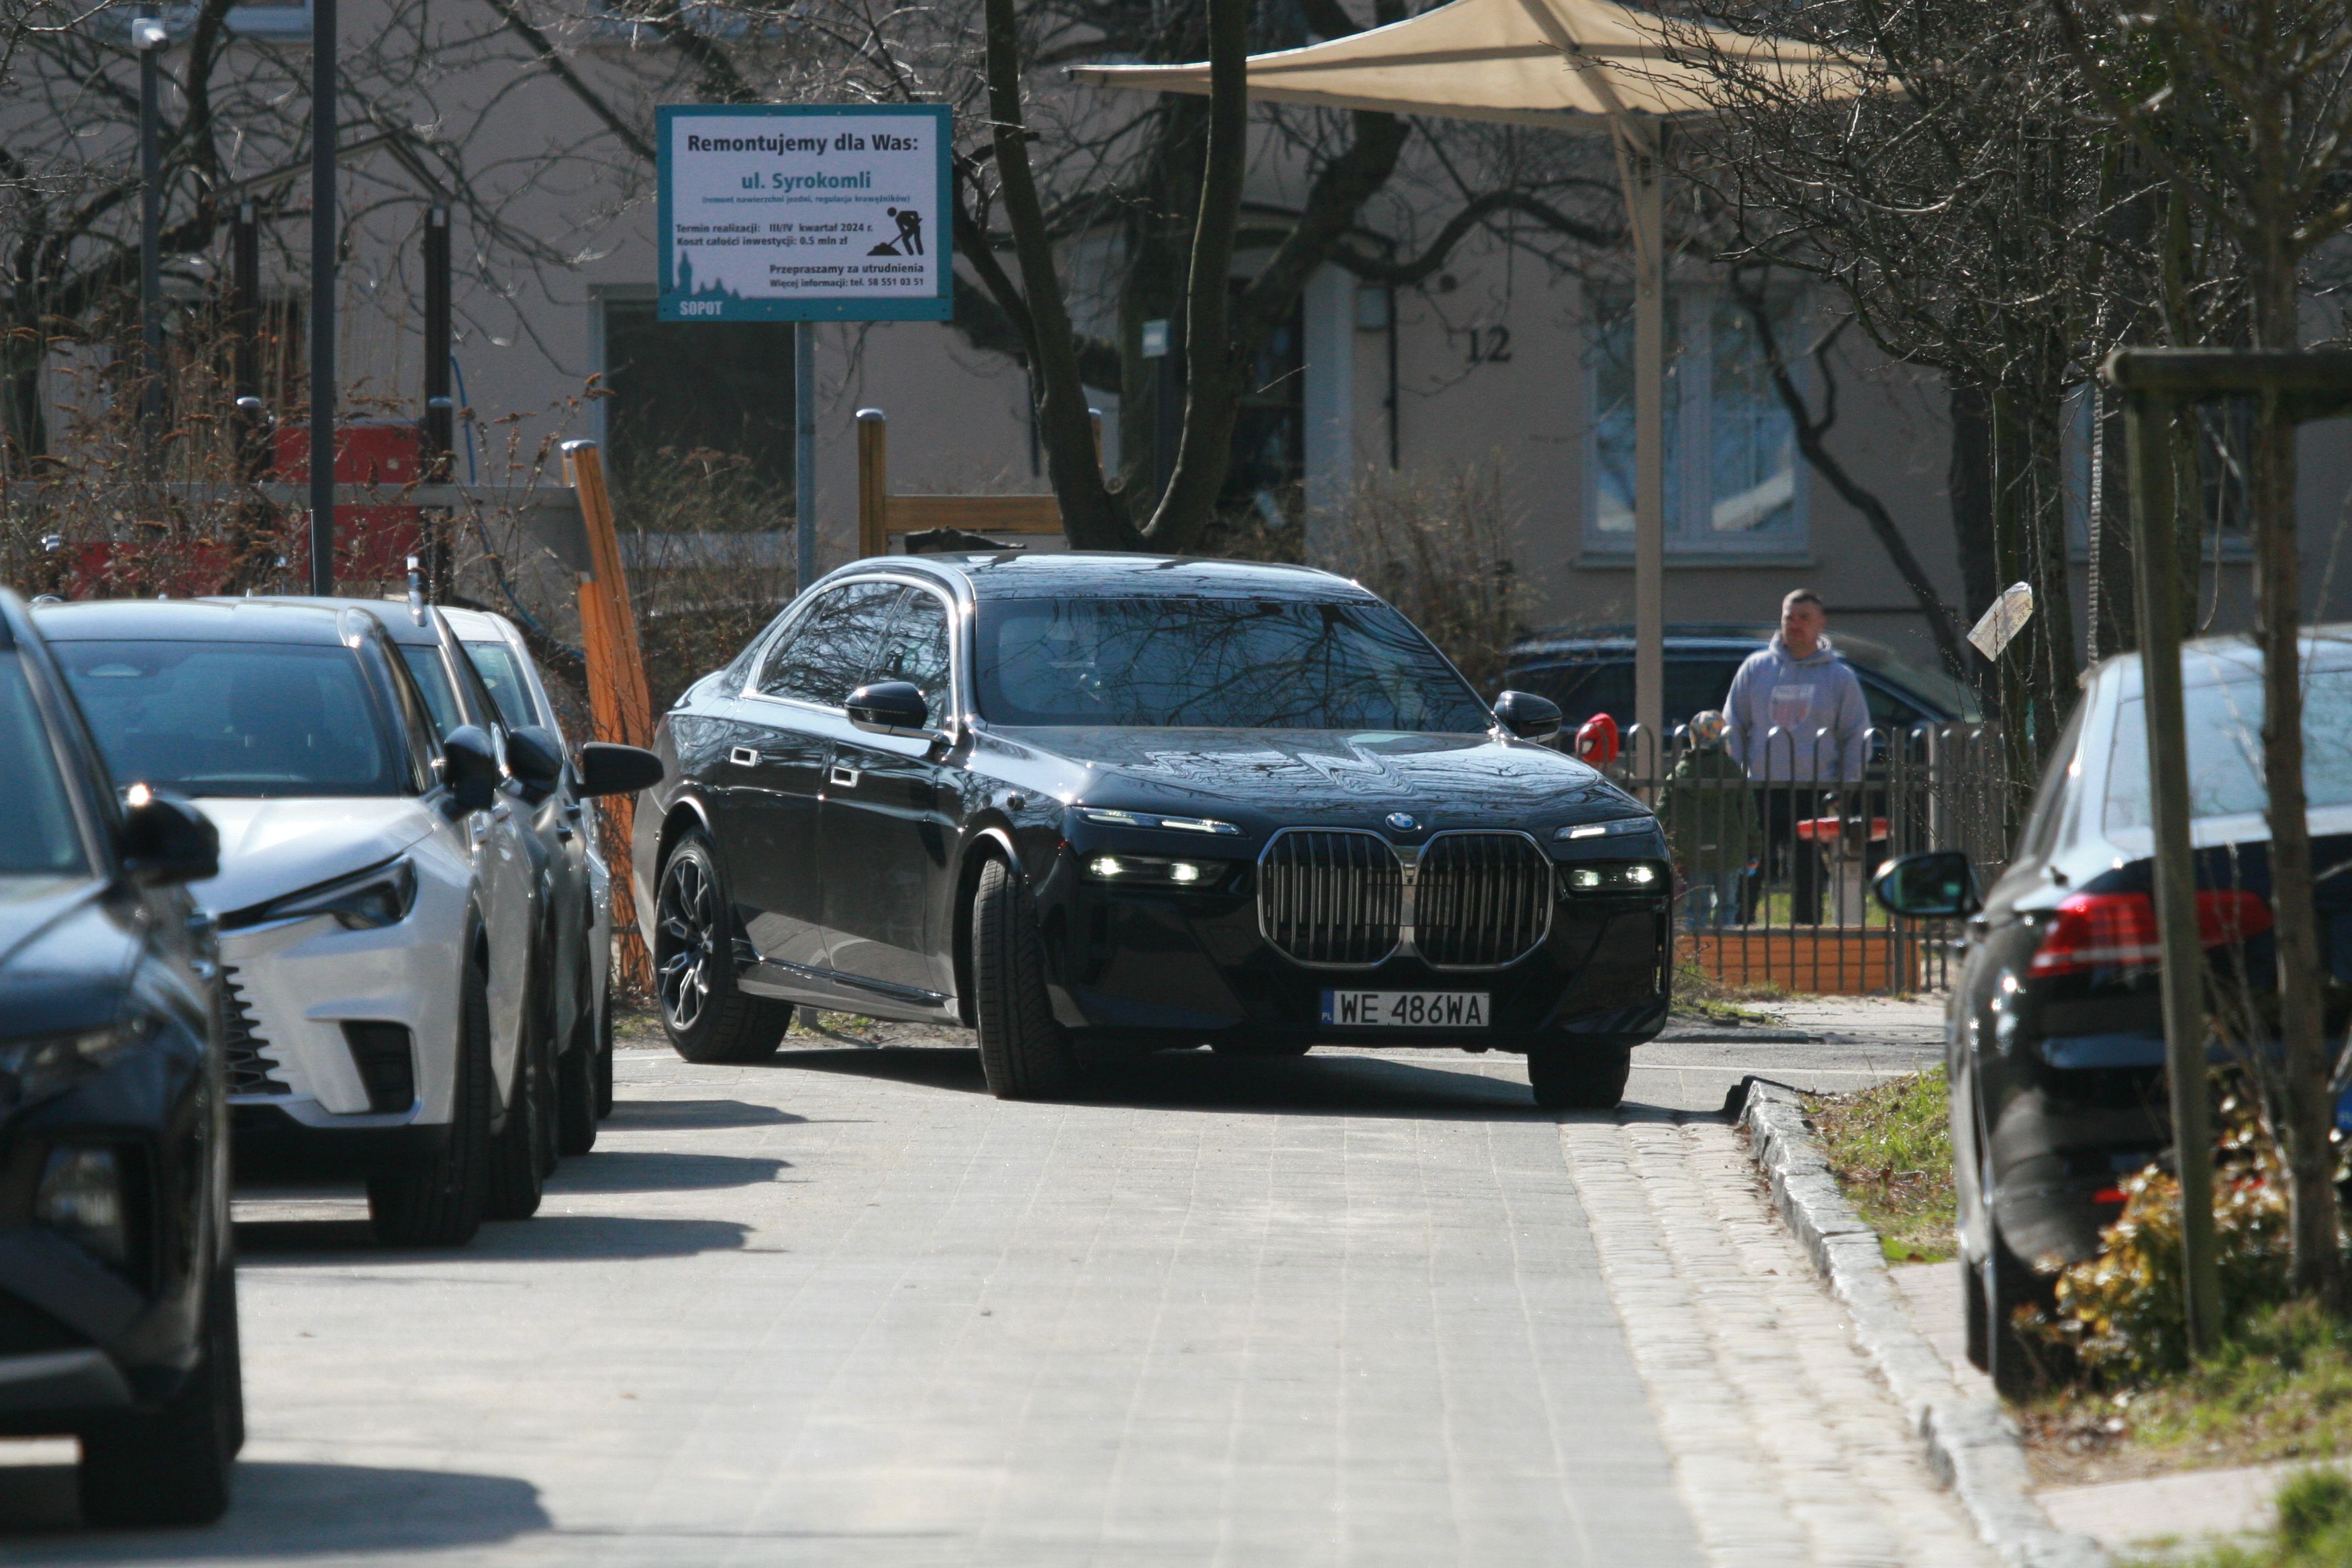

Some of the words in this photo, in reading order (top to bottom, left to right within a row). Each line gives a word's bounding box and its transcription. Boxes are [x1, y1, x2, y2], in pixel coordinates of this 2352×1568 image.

[688, 134, 827, 156] Remontujemy
[834, 134, 865, 151] dla
[873, 134, 918, 151] Was:
[742, 173, 765, 189] ul.
[772, 171, 871, 193] Syrokomli
[677, 224, 709, 233] Termin
[712, 223, 760, 234] realizacji:
[769, 224, 793, 233] III/IV
[799, 223, 837, 232] kwartał
[840, 222, 865, 232] 2024
[677, 237, 703, 246] Koszt
[706, 236, 739, 246] całości
[742, 236, 796, 248] inwestycji:
[818, 236, 836, 245] mln
[840, 236, 848, 245] zł
[770, 264, 844, 276] Przepraszamy
[862, 263, 924, 273] utrudnienia
[770, 279, 799, 289] Więcej
[801, 278, 848, 289] informacji:
[850, 278, 865, 286] tel.
[868, 278, 879, 286] 58
[882, 278, 896, 286] 551
[900, 278, 911, 286] 03
[914, 278, 924, 286] 51
[680, 302, 723, 315] SOPOT
[1469, 326, 1511, 362] 12
[1341, 993, 1379, 1023] WE
[1391, 995, 1481, 1024] 486WA
[1322, 1012, 1332, 1021] PL
